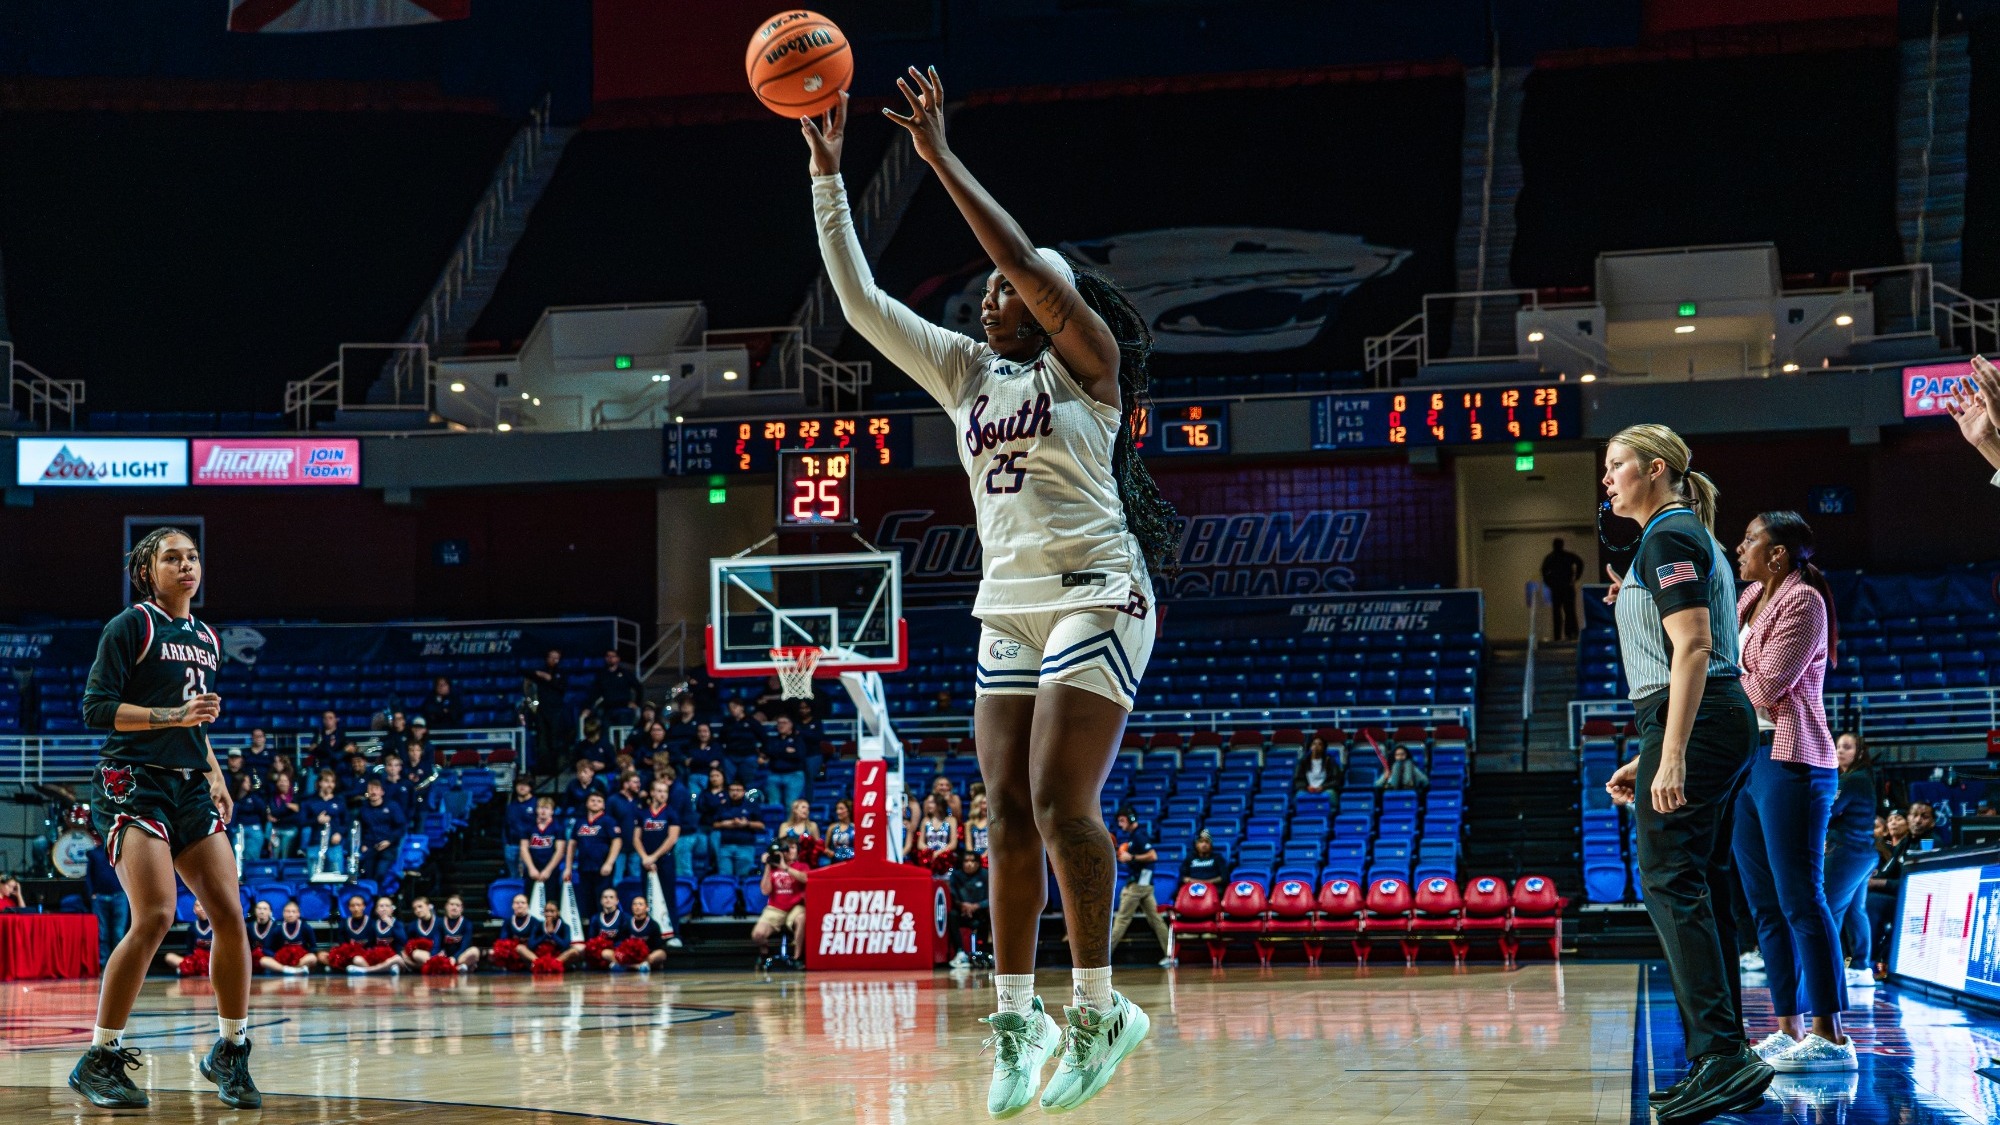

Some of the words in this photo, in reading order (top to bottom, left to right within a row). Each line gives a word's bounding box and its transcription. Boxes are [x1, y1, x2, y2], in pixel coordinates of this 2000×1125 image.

[1394, 395, 1406, 412] 0
[1432, 393, 1444, 411] 6
[1464, 393, 1482, 408] 11
[1502, 390, 1519, 407] 12
[1534, 388, 1558, 406] 23
[740, 423, 751, 440] 0
[764, 422, 786, 439] 20
[799, 421, 820, 438] 22
[834, 420, 855, 436] 24
[868, 418, 890, 435] 25
[966, 393, 1052, 457] South
[1427, 409, 1438, 426] 2
[1181, 424, 1209, 447] 76
[1389, 426, 1407, 443] 12
[1432, 425, 1444, 441] 4
[1471, 423, 1482, 440] 3
[1508, 421, 1520, 437] 9
[1540, 419, 1558, 437] 13
[45, 453, 107, 478] Coors
[112, 461, 168, 478] LIGHT
[200, 446, 294, 473] JAGUAR
[309, 449, 344, 463] JOIN
[740, 453, 751, 470] 2
[880, 447, 890, 465] 3
[801, 456, 847, 478] 7:10
[304, 465, 352, 478] TODAY!
[986, 451, 1029, 494] 25
[793, 479, 840, 518] 25
[875, 509, 983, 577] SOU
[1176, 510, 1370, 568] BAMA
[160, 642, 217, 672] ARKANSAS
[861, 766, 879, 850] JAGS
[831, 890, 905, 914] LOYAL,
[821, 913, 895, 932] STRONG
[899, 912, 916, 930] &
[818, 931, 918, 955] FAITHFUL
